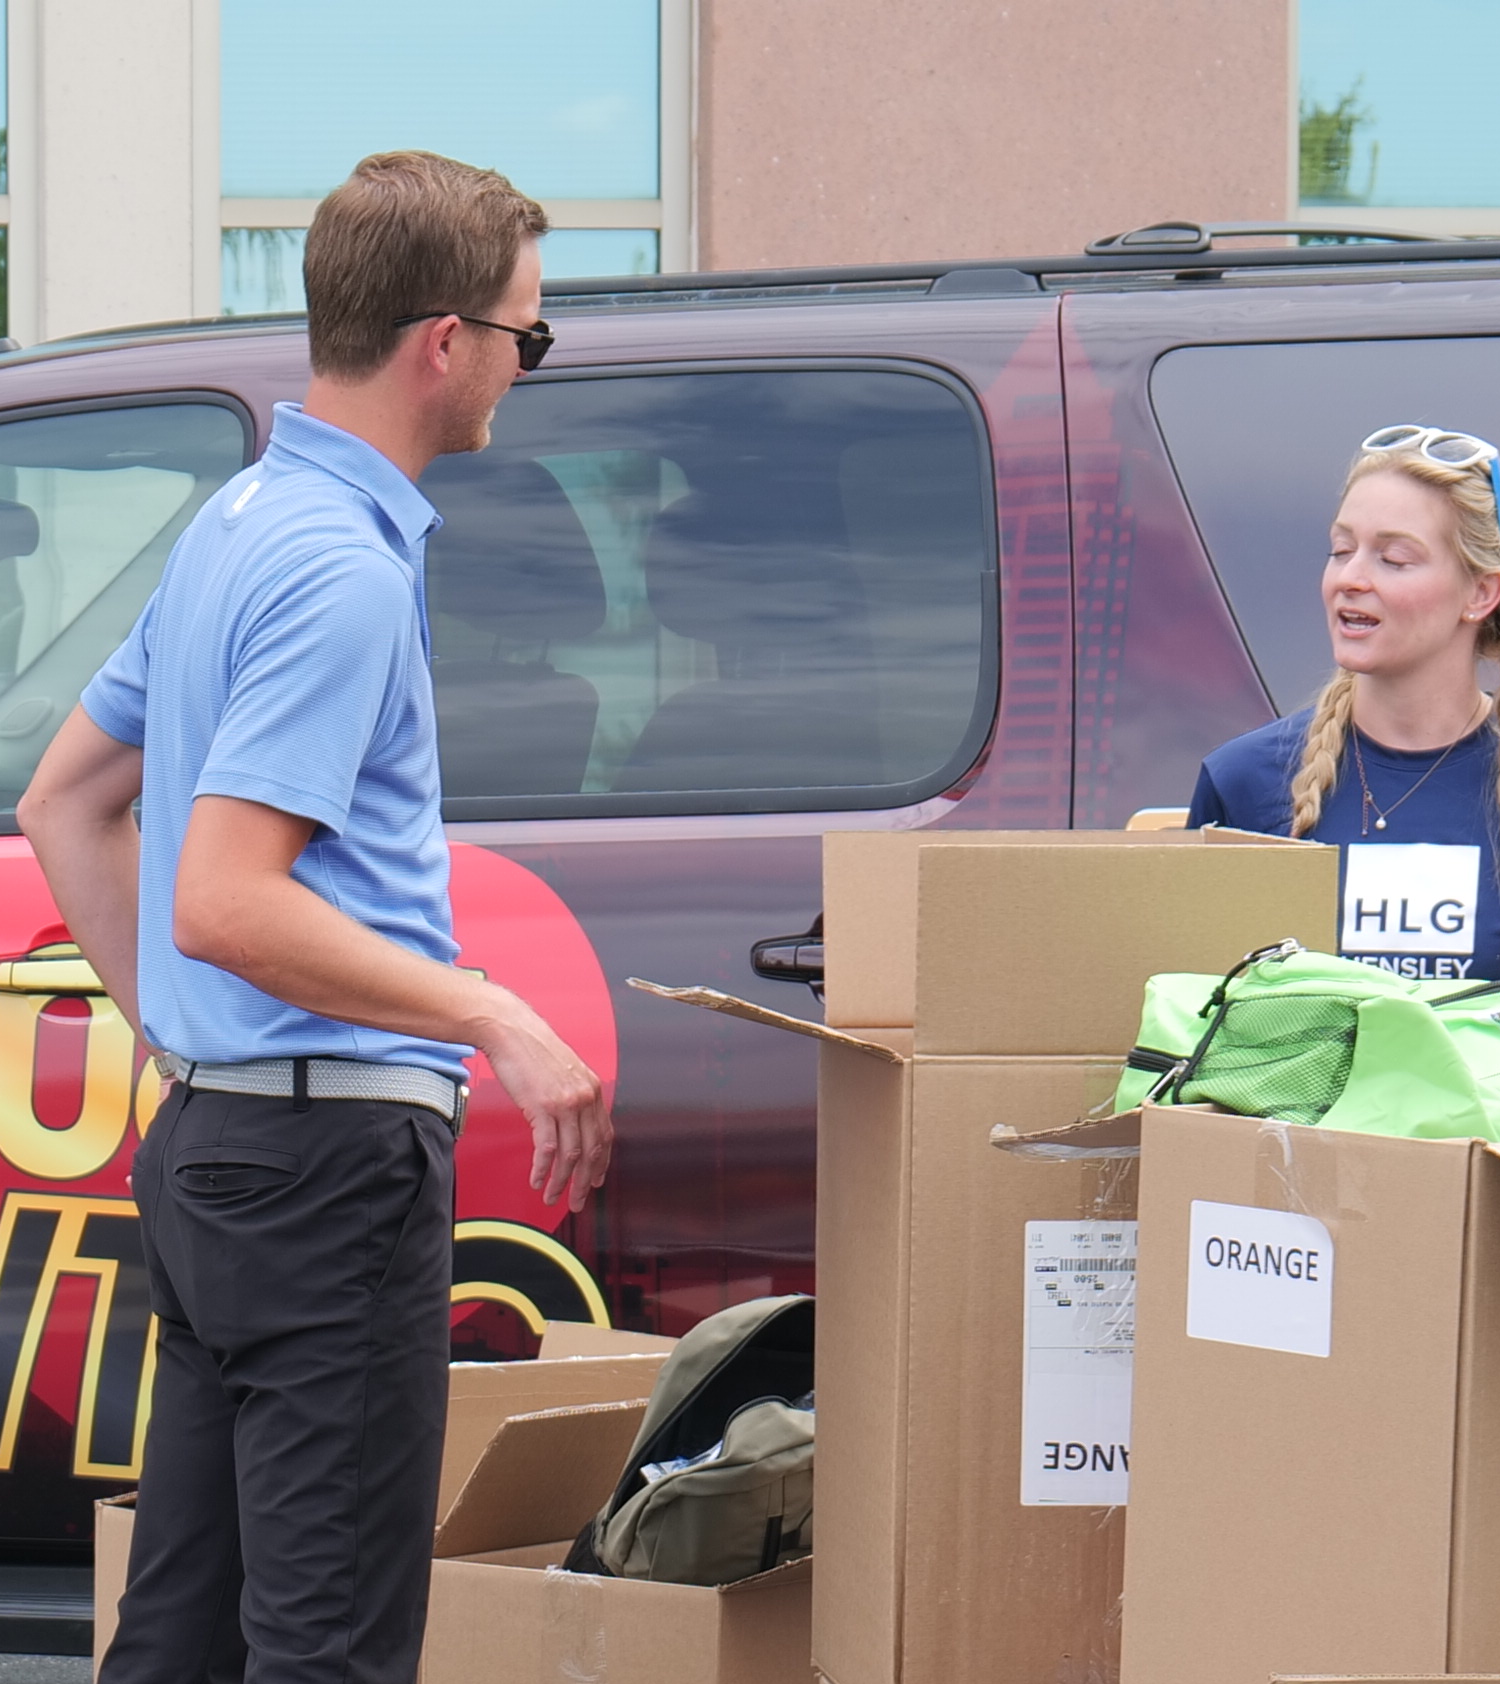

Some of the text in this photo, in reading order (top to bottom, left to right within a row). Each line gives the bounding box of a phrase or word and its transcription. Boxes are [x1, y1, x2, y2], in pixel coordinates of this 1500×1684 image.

[1355, 898, 1465, 933] HLG
[1342, 956, 1474, 979] NSLEY
[1205, 1236, 1319, 1282] ORANGE
